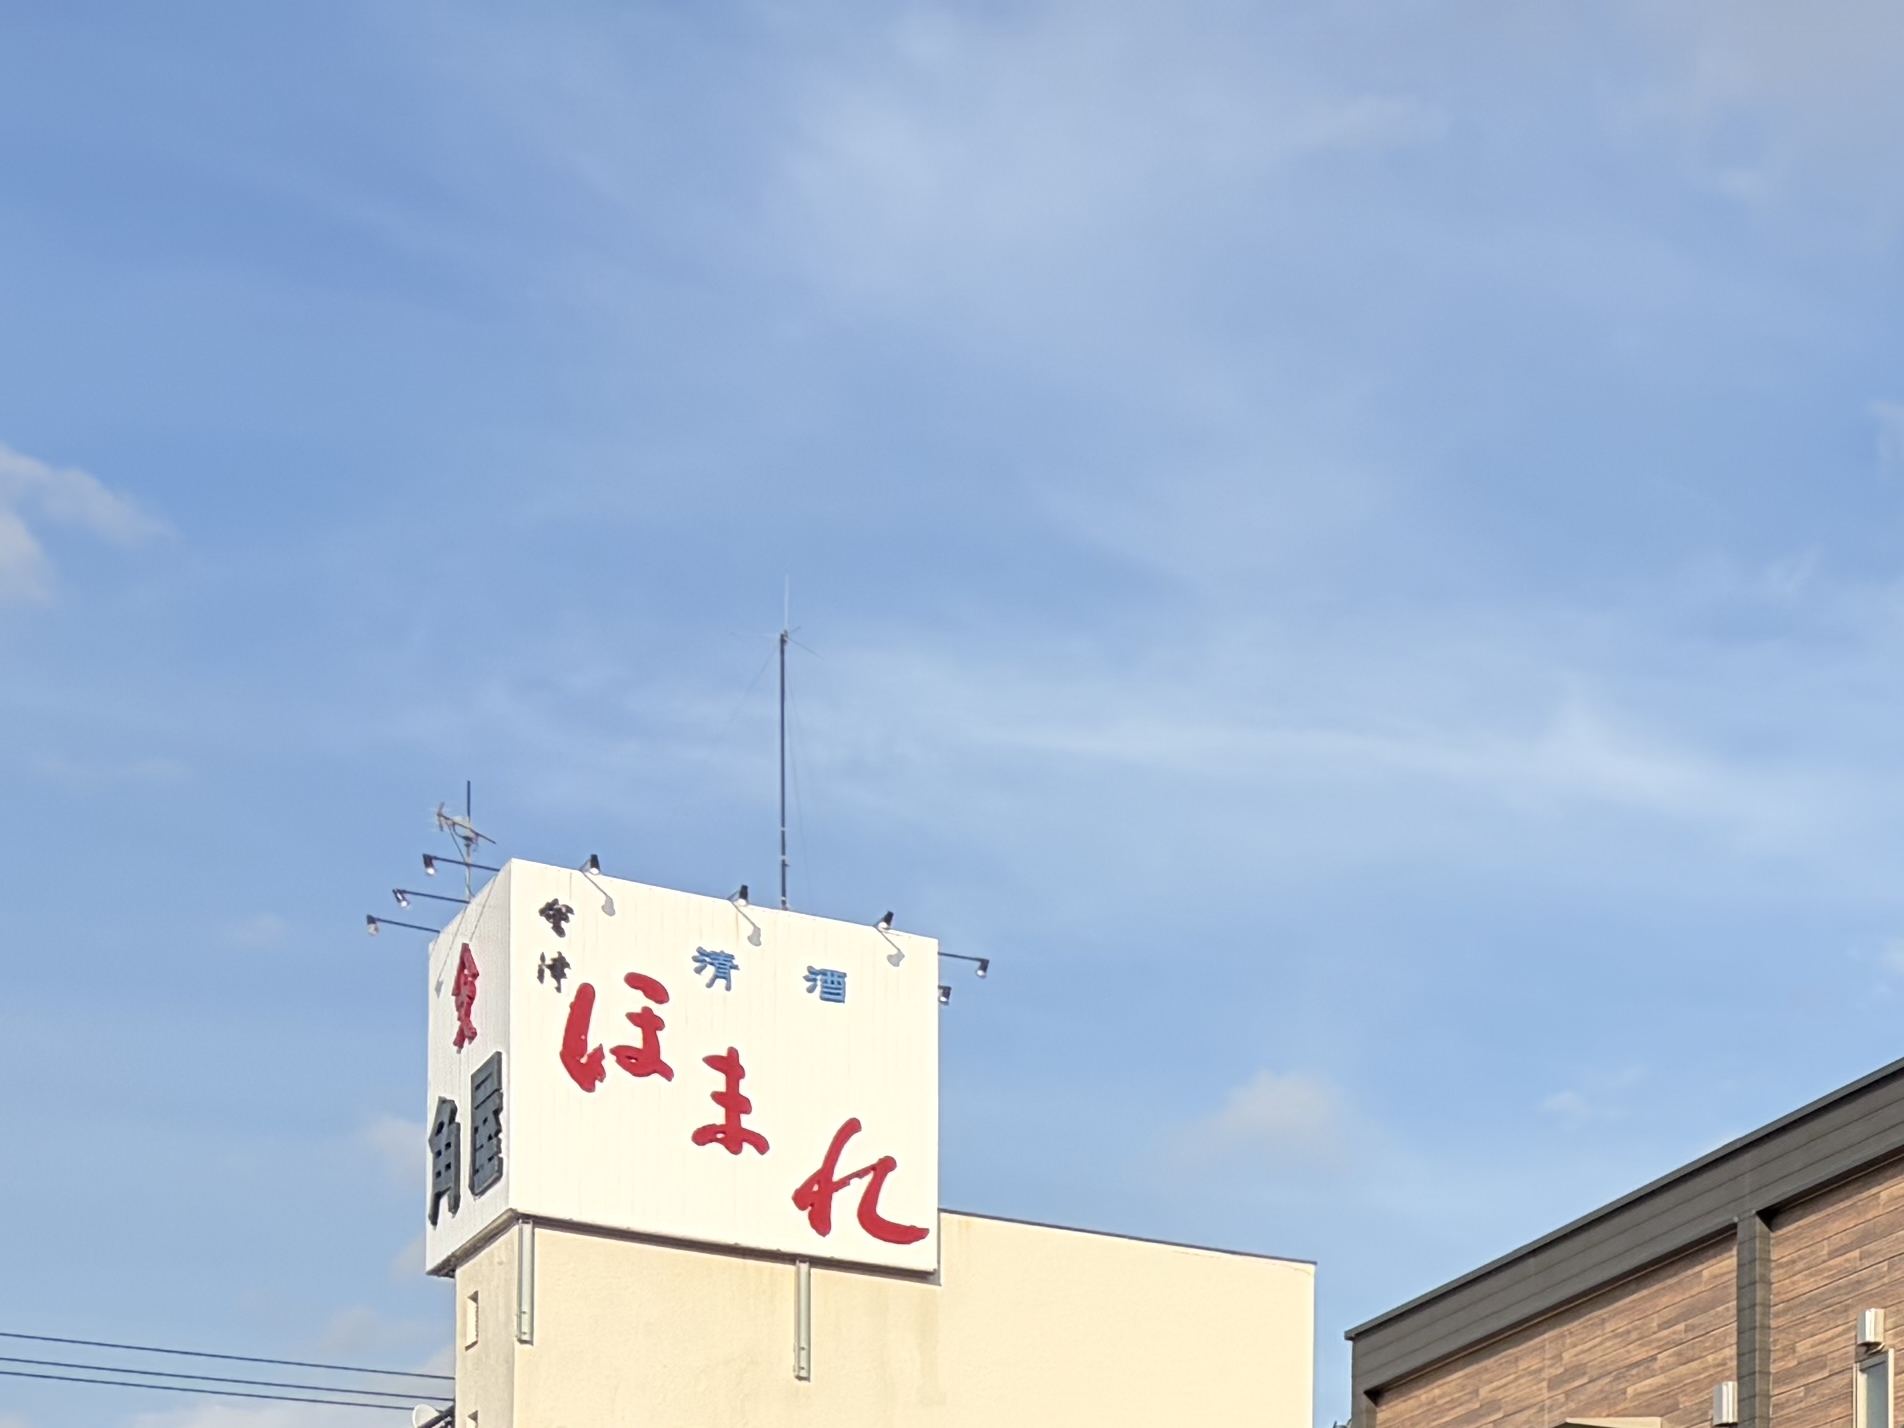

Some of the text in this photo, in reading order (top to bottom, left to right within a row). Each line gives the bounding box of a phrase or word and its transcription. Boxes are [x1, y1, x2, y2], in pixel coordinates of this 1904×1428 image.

[691, 946, 849, 1004] 清酒
[558, 971, 931, 1246] ほまれ
